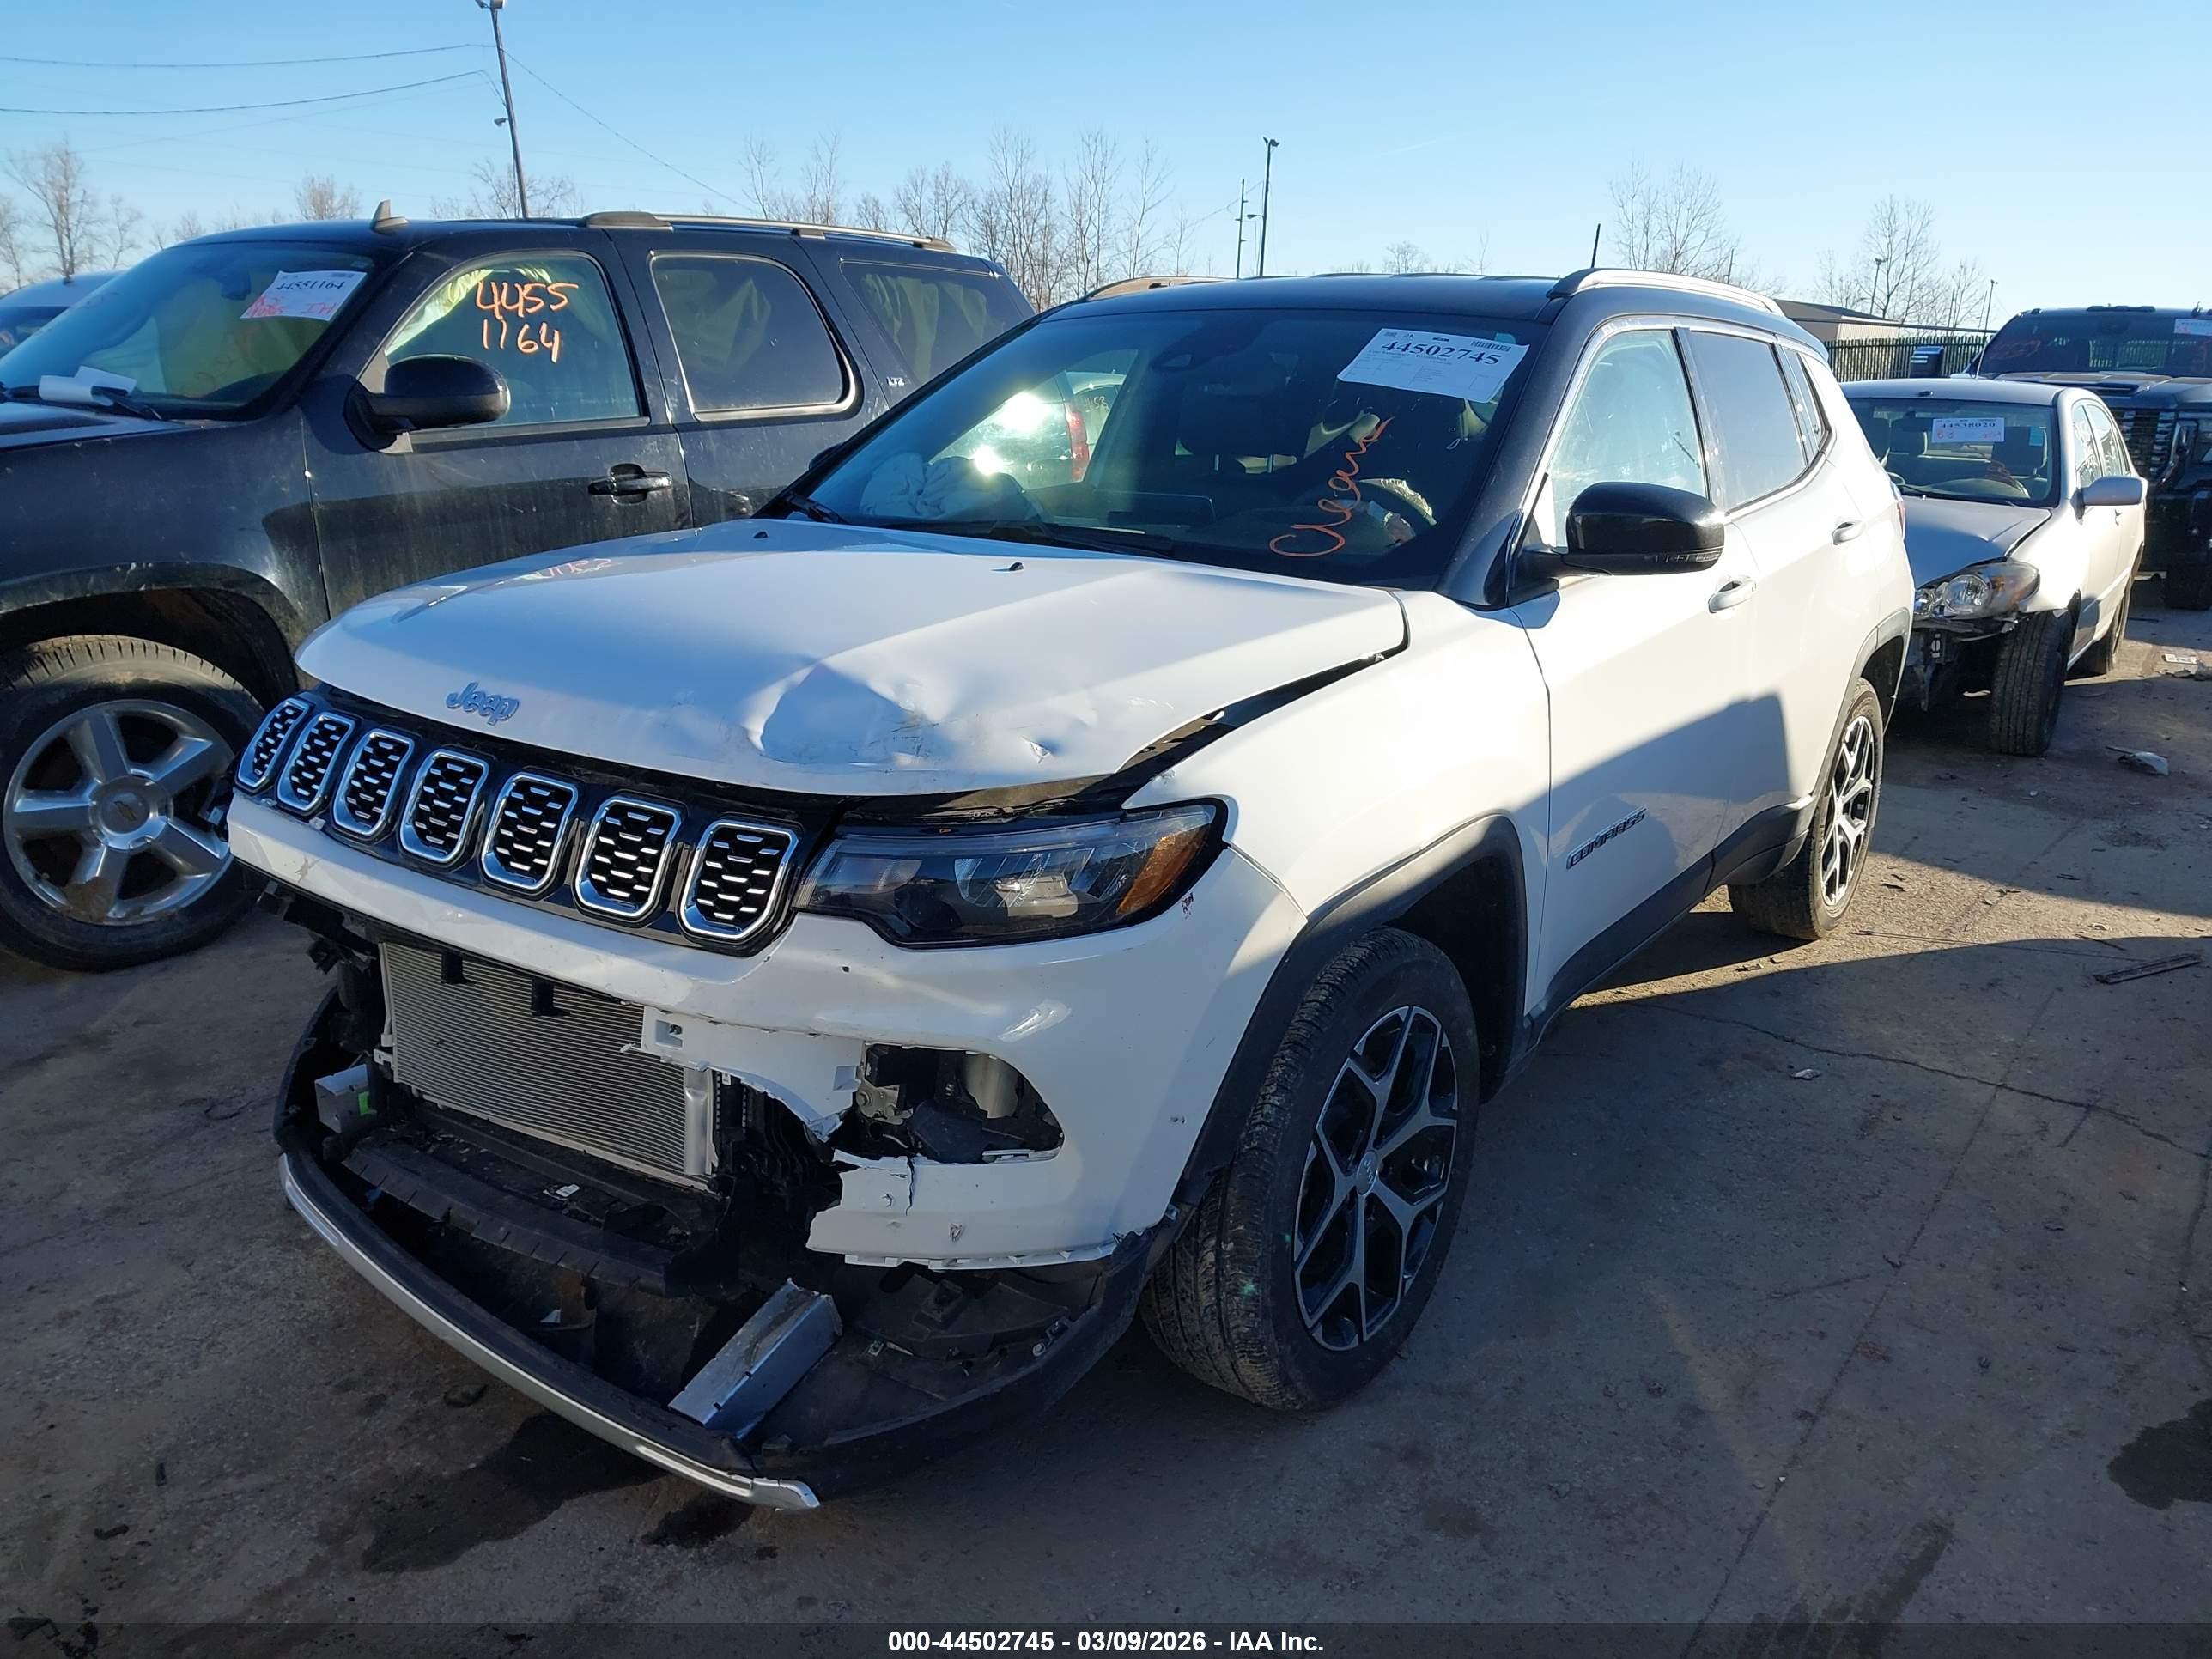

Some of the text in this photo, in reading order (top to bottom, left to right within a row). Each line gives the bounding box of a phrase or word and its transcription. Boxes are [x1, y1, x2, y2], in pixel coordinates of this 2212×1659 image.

[276, 280, 346, 290] 44551164
[476, 280, 580, 320] 4455
[483, 319, 561, 364] 1164
[1381, 340, 1503, 366] 44502745
[446, 682, 520, 726] Jeep
[1566, 806, 1648, 870] COMPASS
